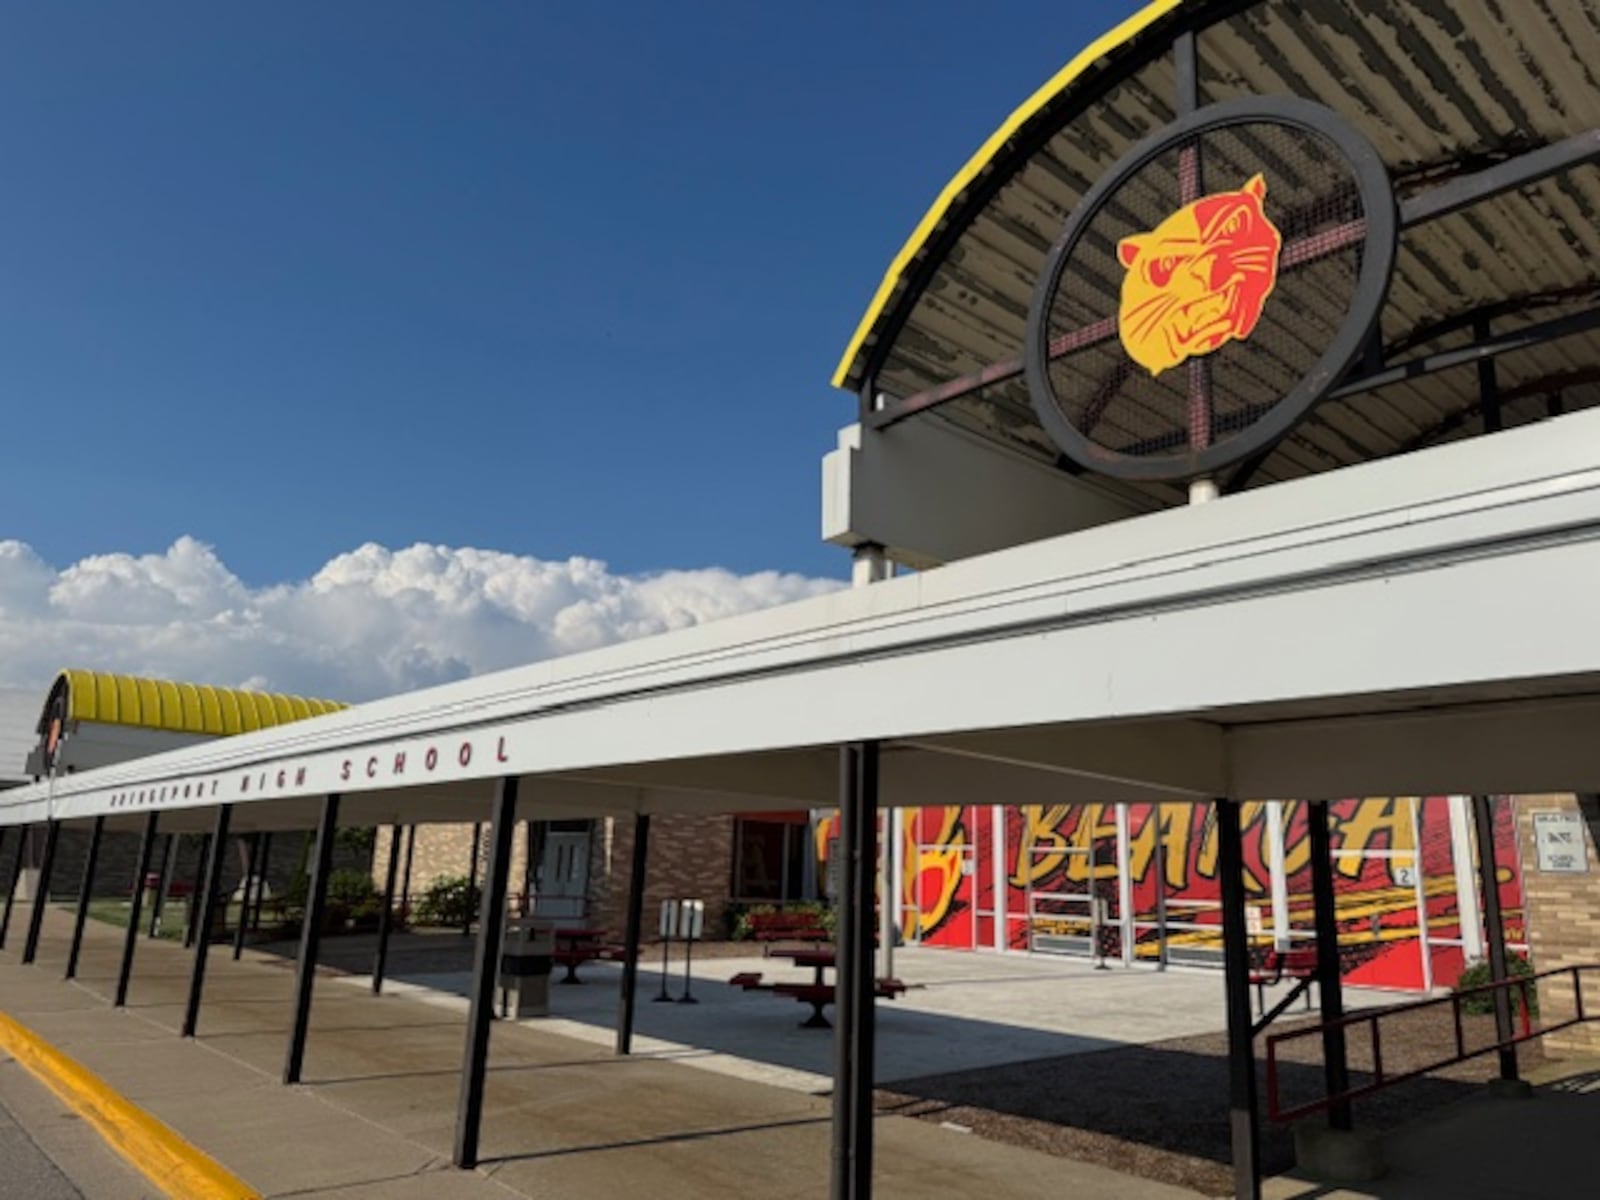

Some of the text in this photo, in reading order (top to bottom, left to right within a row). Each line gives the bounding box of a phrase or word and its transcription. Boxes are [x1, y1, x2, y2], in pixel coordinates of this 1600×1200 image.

[110, 736, 508, 807] BRIDGEPORT HIGH SCHOOL
[1399, 869, 1409, 884] 2
